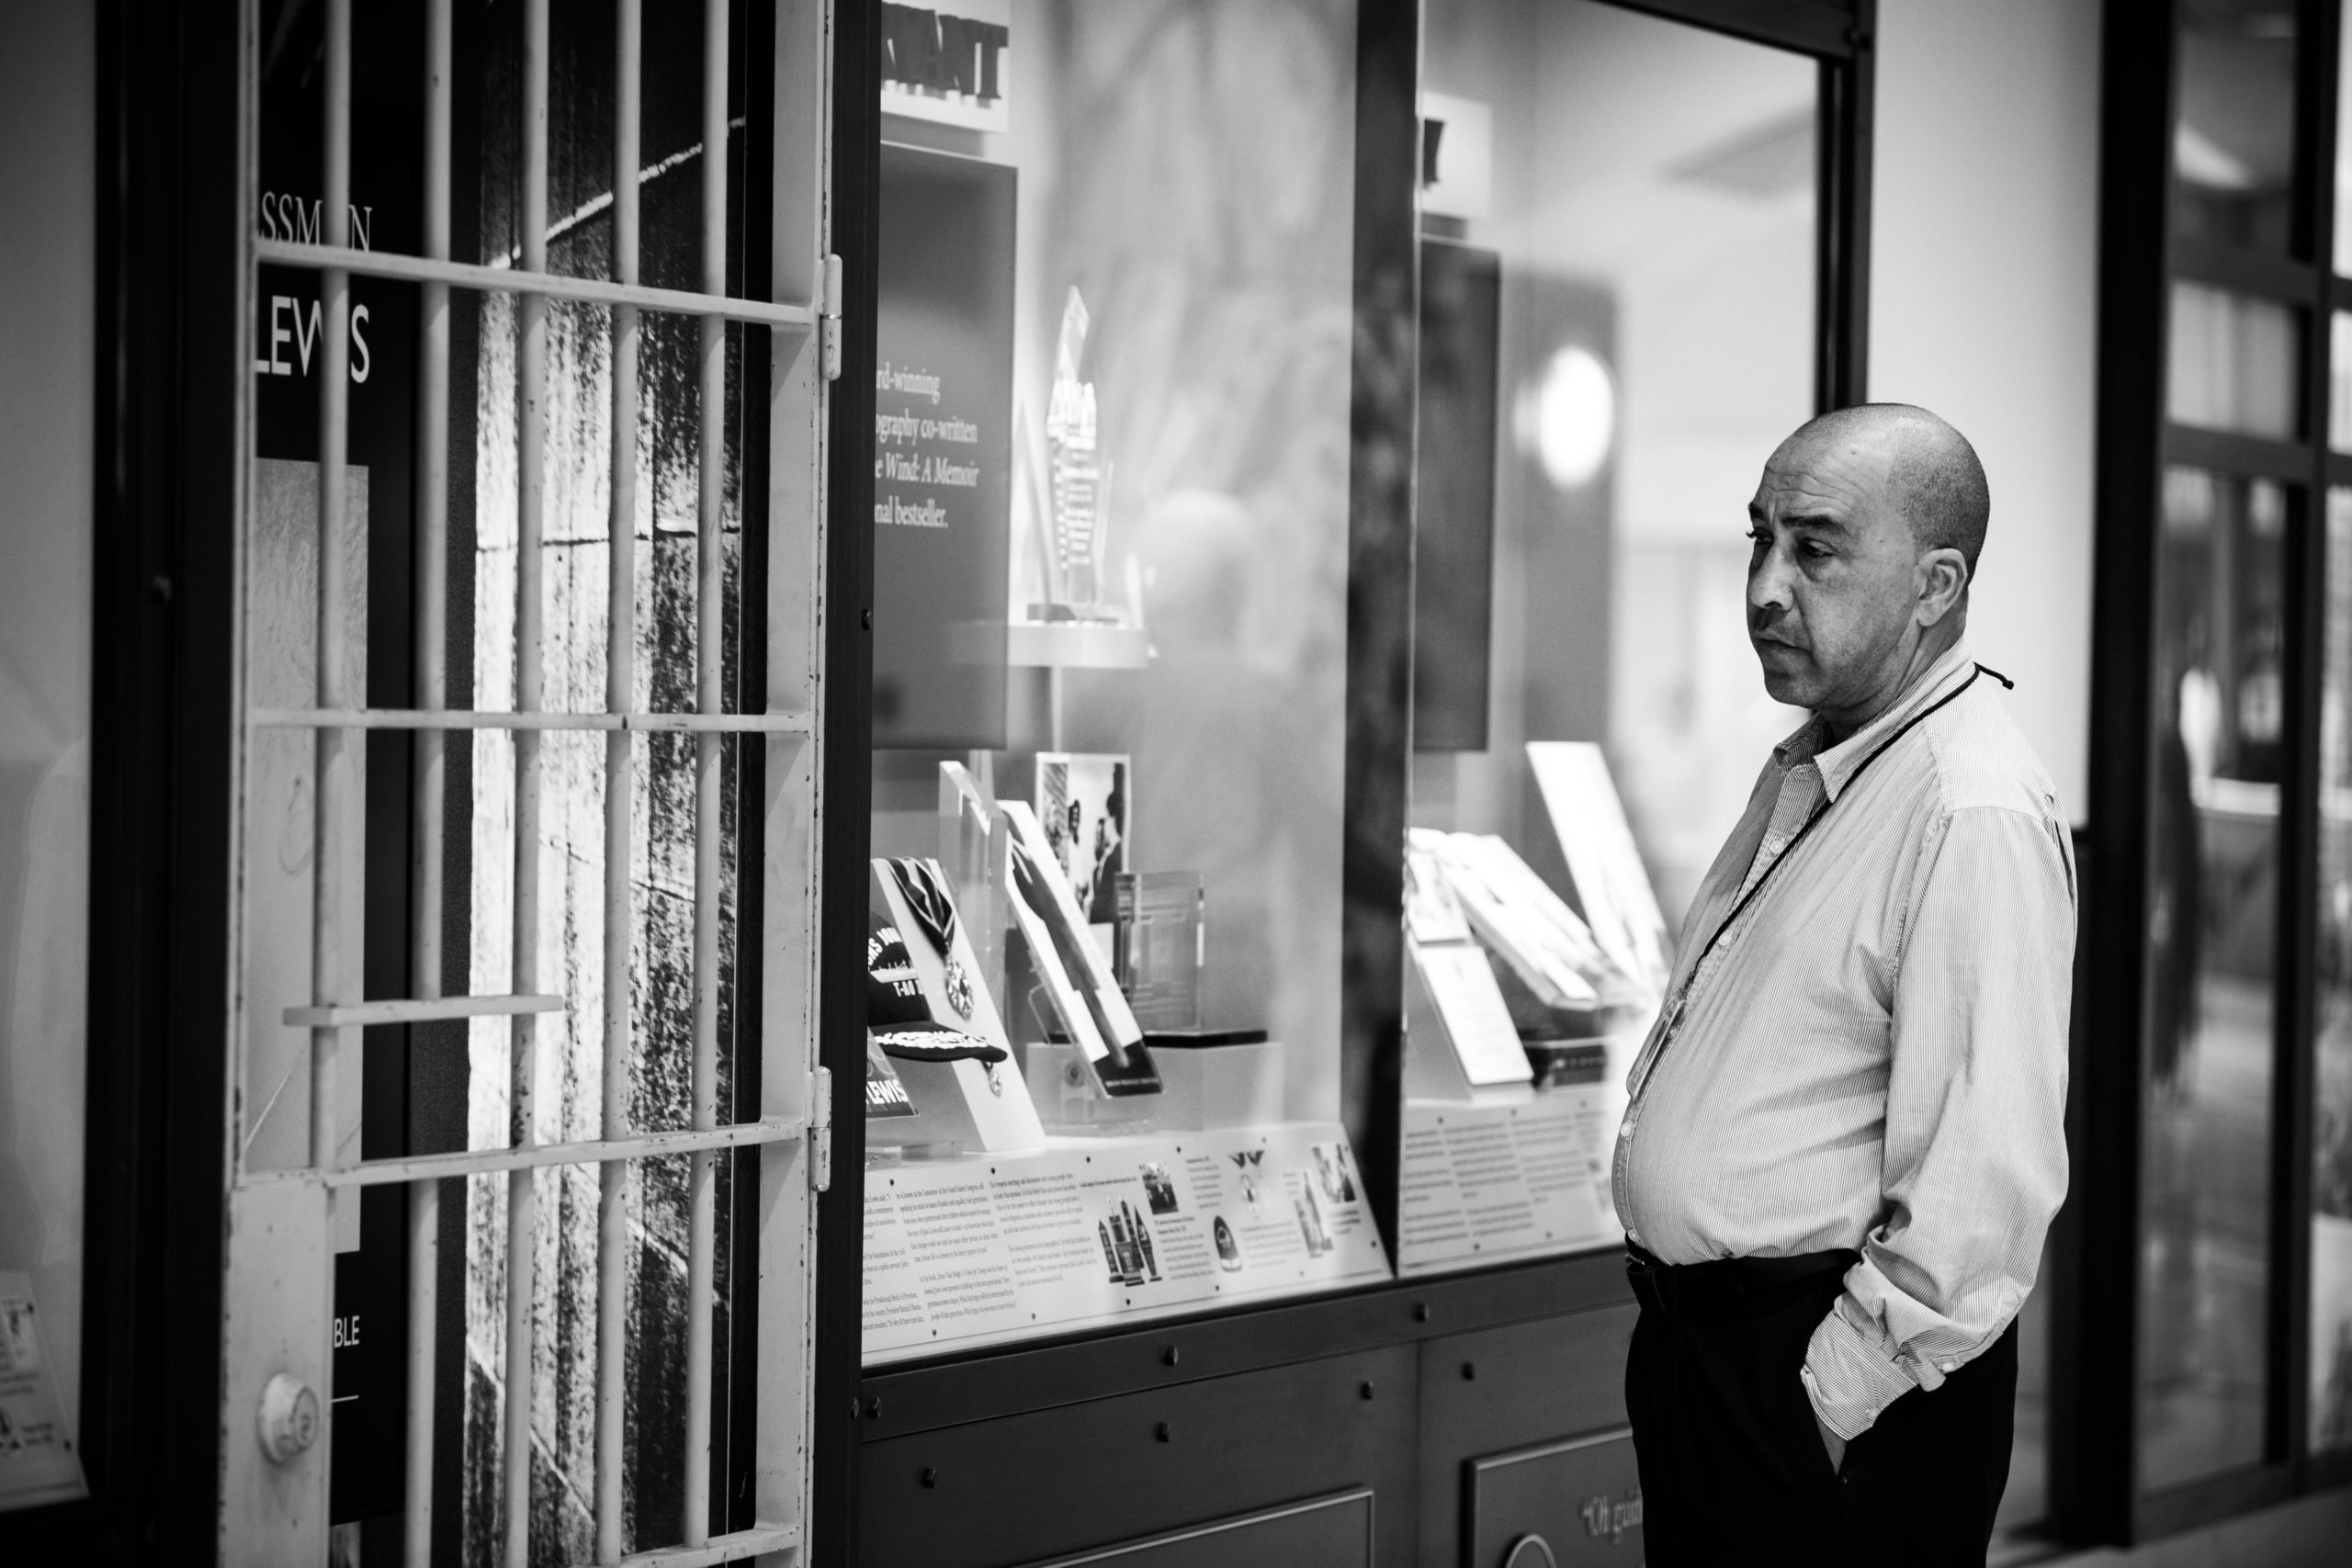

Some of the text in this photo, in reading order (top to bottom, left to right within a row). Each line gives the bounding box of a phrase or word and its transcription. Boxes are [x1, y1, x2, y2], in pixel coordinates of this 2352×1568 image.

[261, 190, 372, 251] SSMN
[254, 294, 370, 384] EWS
[921, 415, 978, 444] co-written
[921, 456, 933, 483] A
[933, 457, 979, 488] Memoir
[895, 495, 949, 528] bestseller.
[866, 1078, 909, 1104] LEWIS
[334, 1314, 359, 1348] BLE
